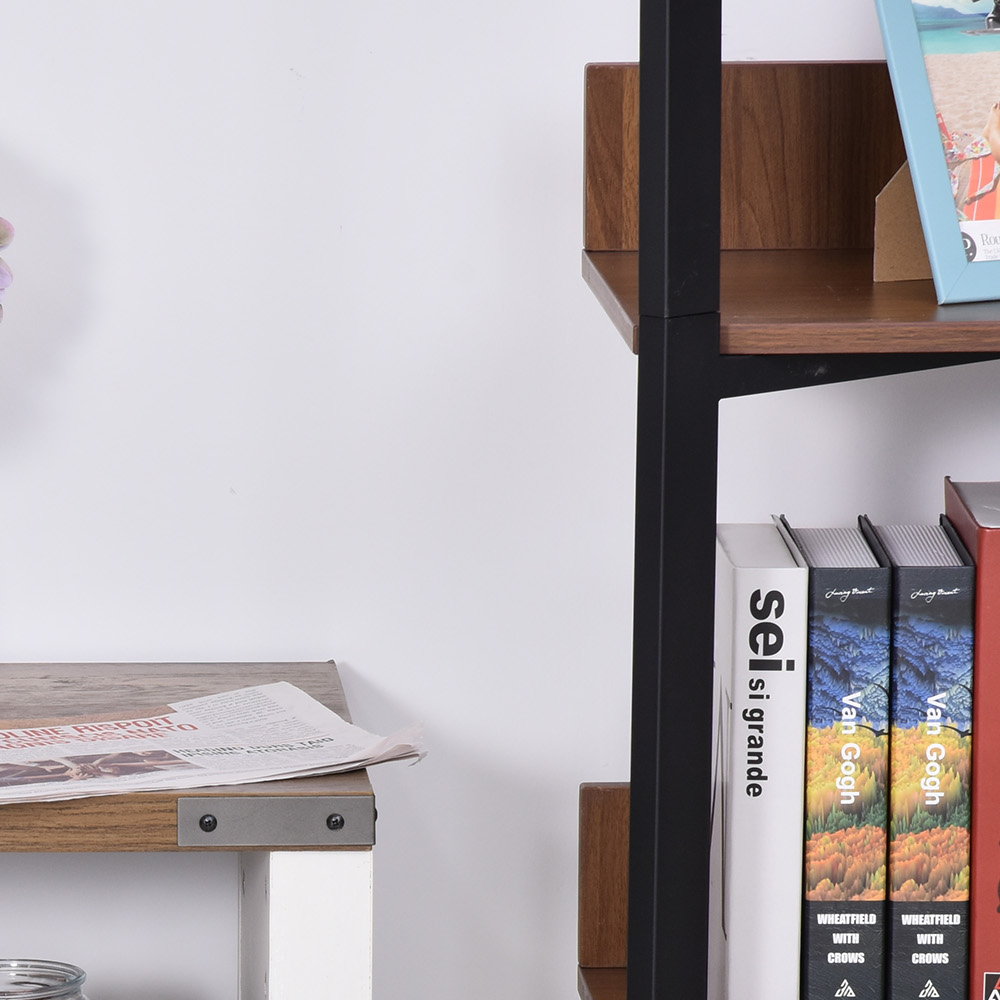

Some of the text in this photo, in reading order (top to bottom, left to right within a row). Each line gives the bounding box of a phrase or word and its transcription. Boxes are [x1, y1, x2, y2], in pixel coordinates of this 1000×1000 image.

[748, 678, 771, 700] si
[741, 707, 768, 798] grande
[836, 691, 862, 805] Van Gogh
[920, 691, 947, 806] Van Gogh
[816, 913, 877, 925] WHEATFIELD
[901, 914, 961, 925] WHEATFIELD
[832, 933, 860, 944] WITH
[916, 933, 944, 945] WITH
[827, 952, 865, 964] CROWS
[911, 953, 949, 964] CROWS
